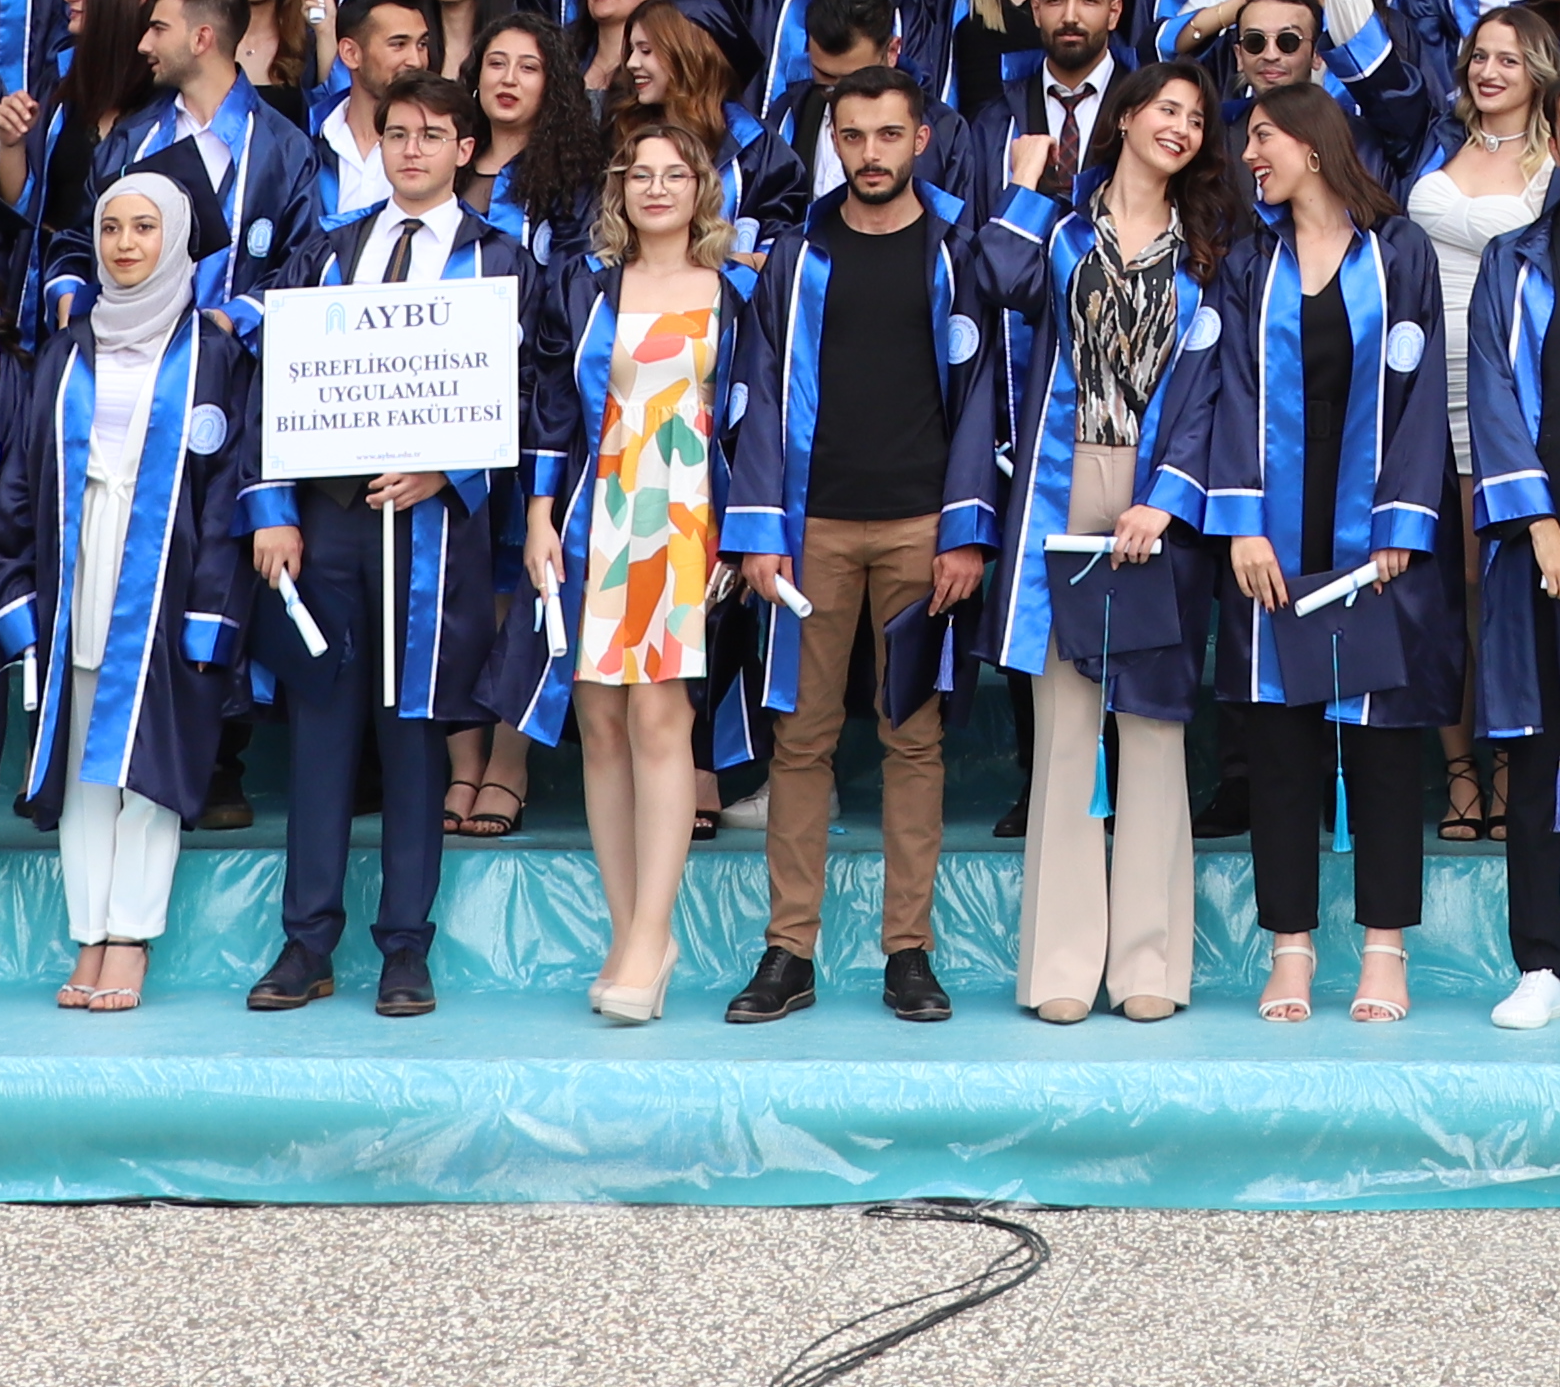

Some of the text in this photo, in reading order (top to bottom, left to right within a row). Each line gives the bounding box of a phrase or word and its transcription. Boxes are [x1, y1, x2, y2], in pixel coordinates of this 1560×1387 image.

[355, 296, 452, 330] AYBÜ
[289, 348, 489, 383] ŞEREFLİKOÇHİSAR
[318, 380, 459, 403] UYGULAMALI
[276, 400, 503, 433] BİLİMLER FAKÜLTESİ
